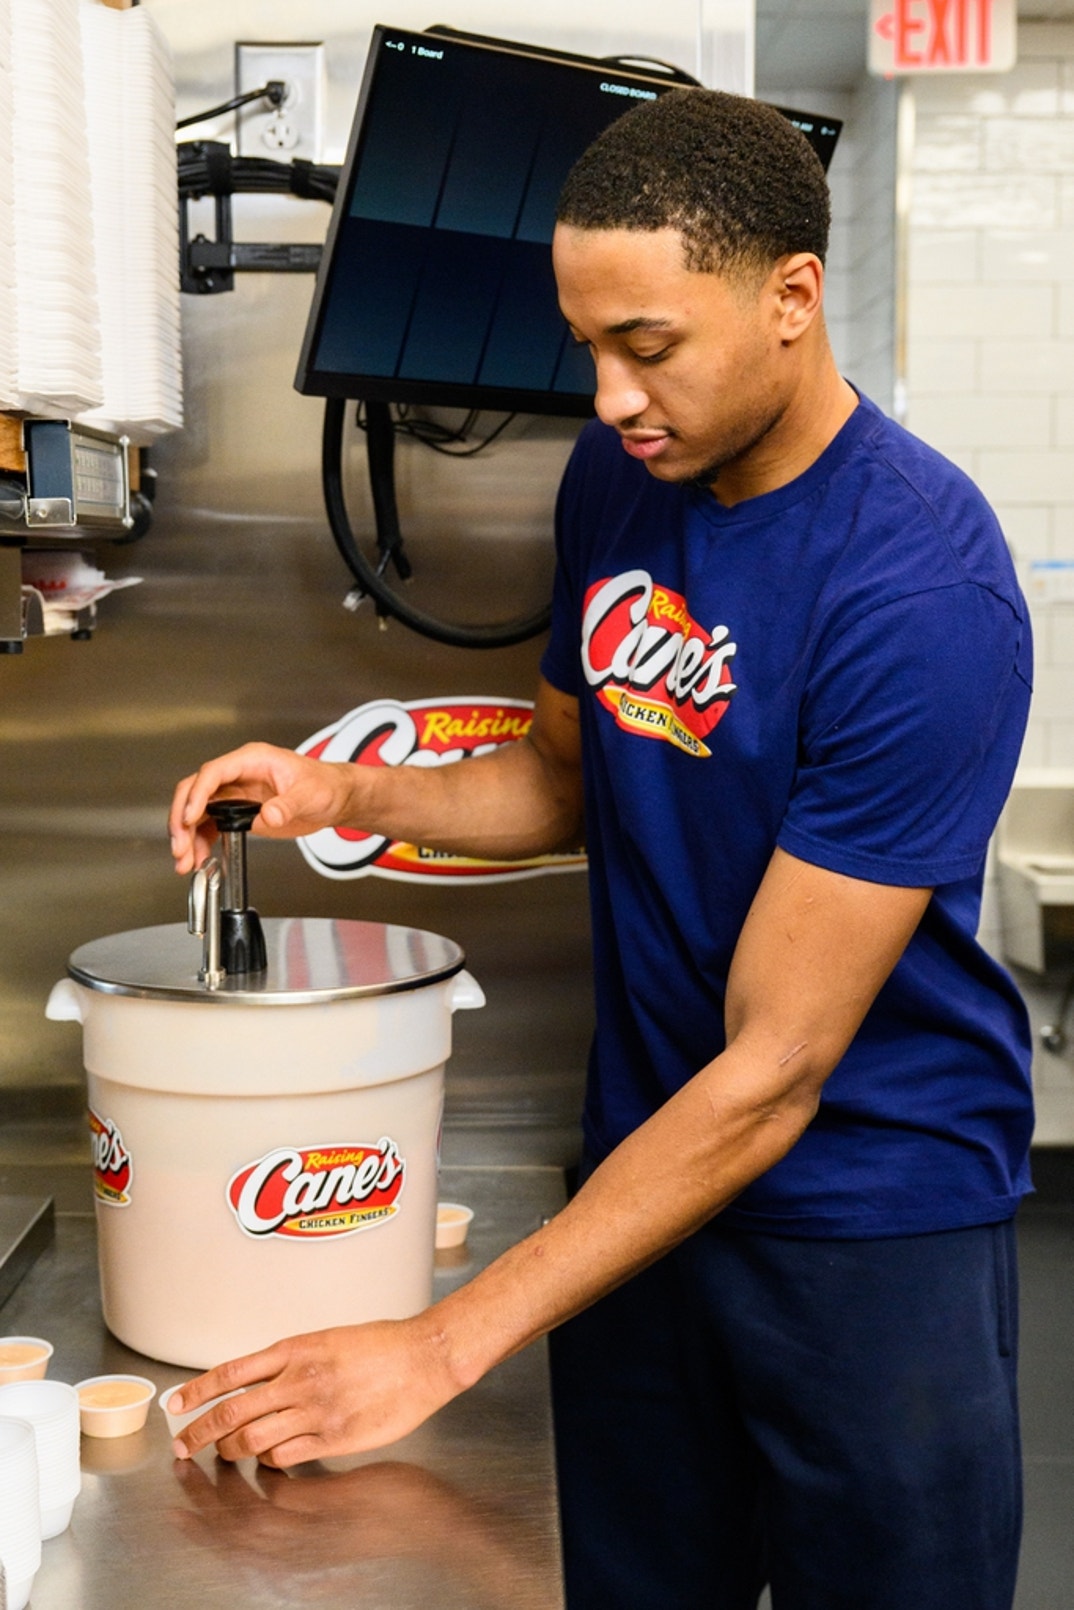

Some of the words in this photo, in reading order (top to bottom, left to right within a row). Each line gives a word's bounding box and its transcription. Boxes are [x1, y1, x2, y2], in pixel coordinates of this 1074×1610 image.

[418, 47, 444, 60] Board
[600, 83, 630, 96] CLOSED
[304, 1149, 364, 1170] Raising
[238, 1139, 403, 1233] Cane's
[298, 1216, 345, 1230] CHICKEN
[350, 1206, 390, 1225] FINGERS
